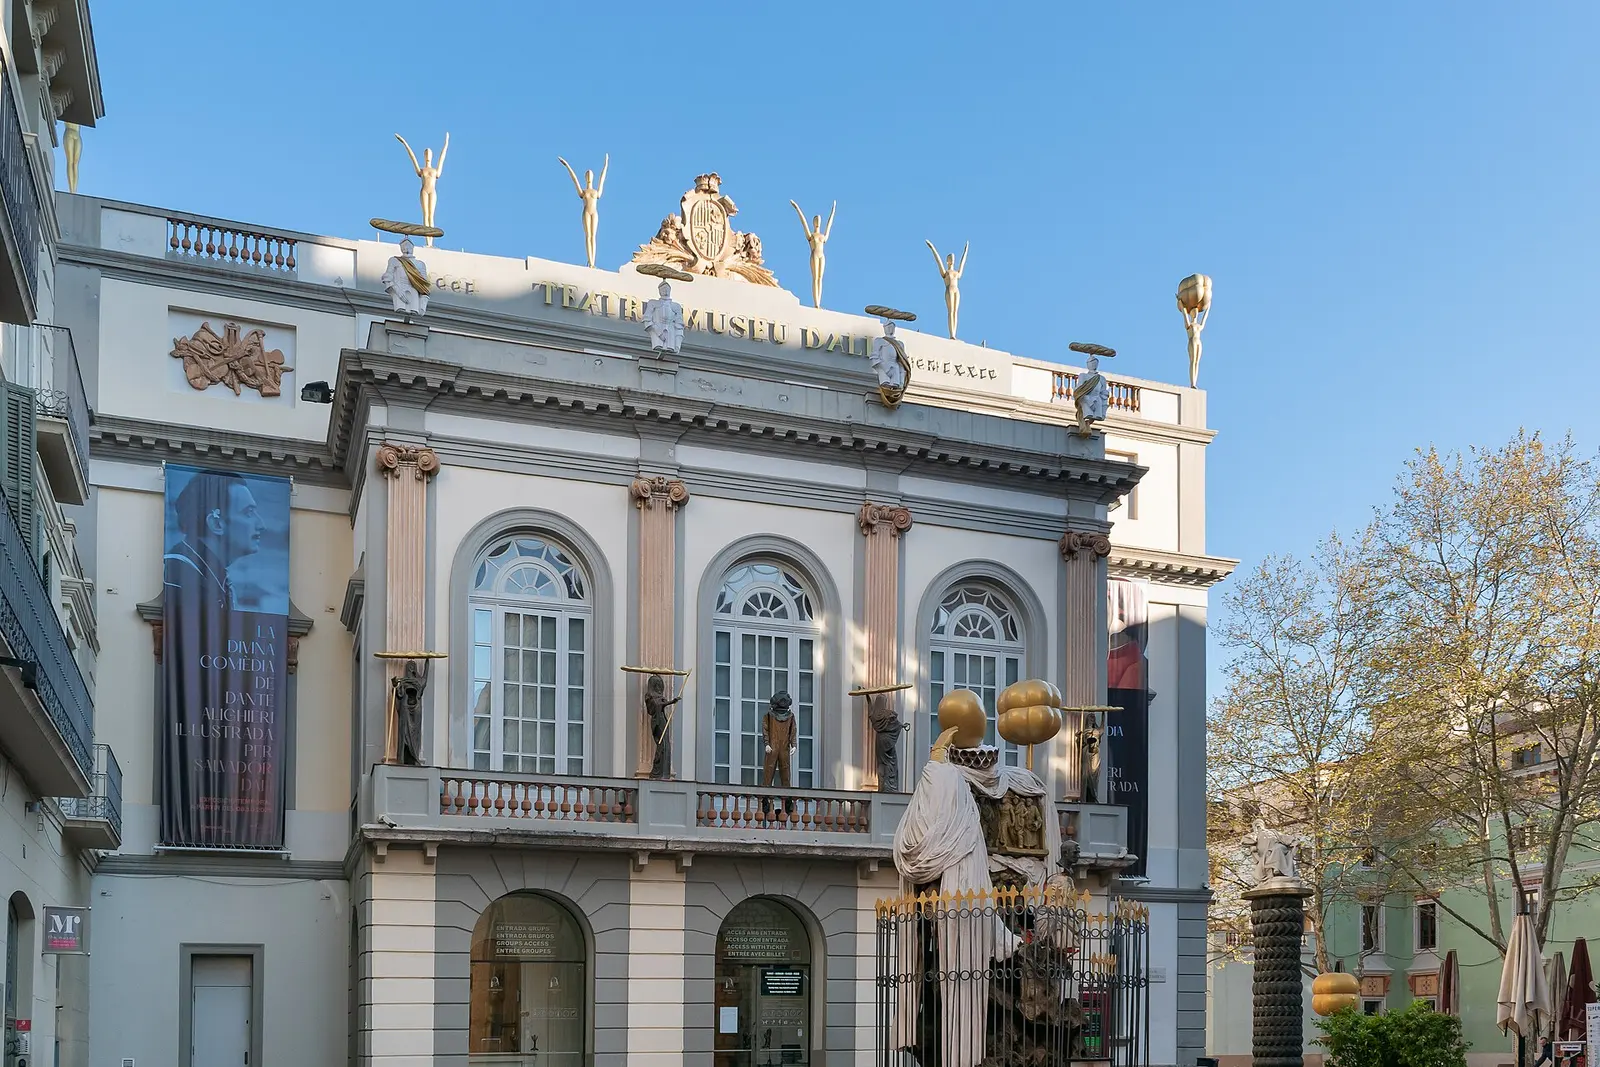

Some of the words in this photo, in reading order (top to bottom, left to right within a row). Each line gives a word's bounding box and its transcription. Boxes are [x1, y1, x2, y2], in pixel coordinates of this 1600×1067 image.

[534, 280, 645, 322] TEATR
[682, 304, 790, 345] MUSEU
[257, 625, 275, 639] LA
[227, 639, 275, 656] DIVINA
[200, 654, 275, 673] COMÈDIA
[255, 676, 275, 690] DE
[225, 691, 274, 707] DANTE
[202, 706, 274, 724] ALIGHIERI
[244, 744, 272, 758] PER
[194, 759, 273, 775] SALVADOR
